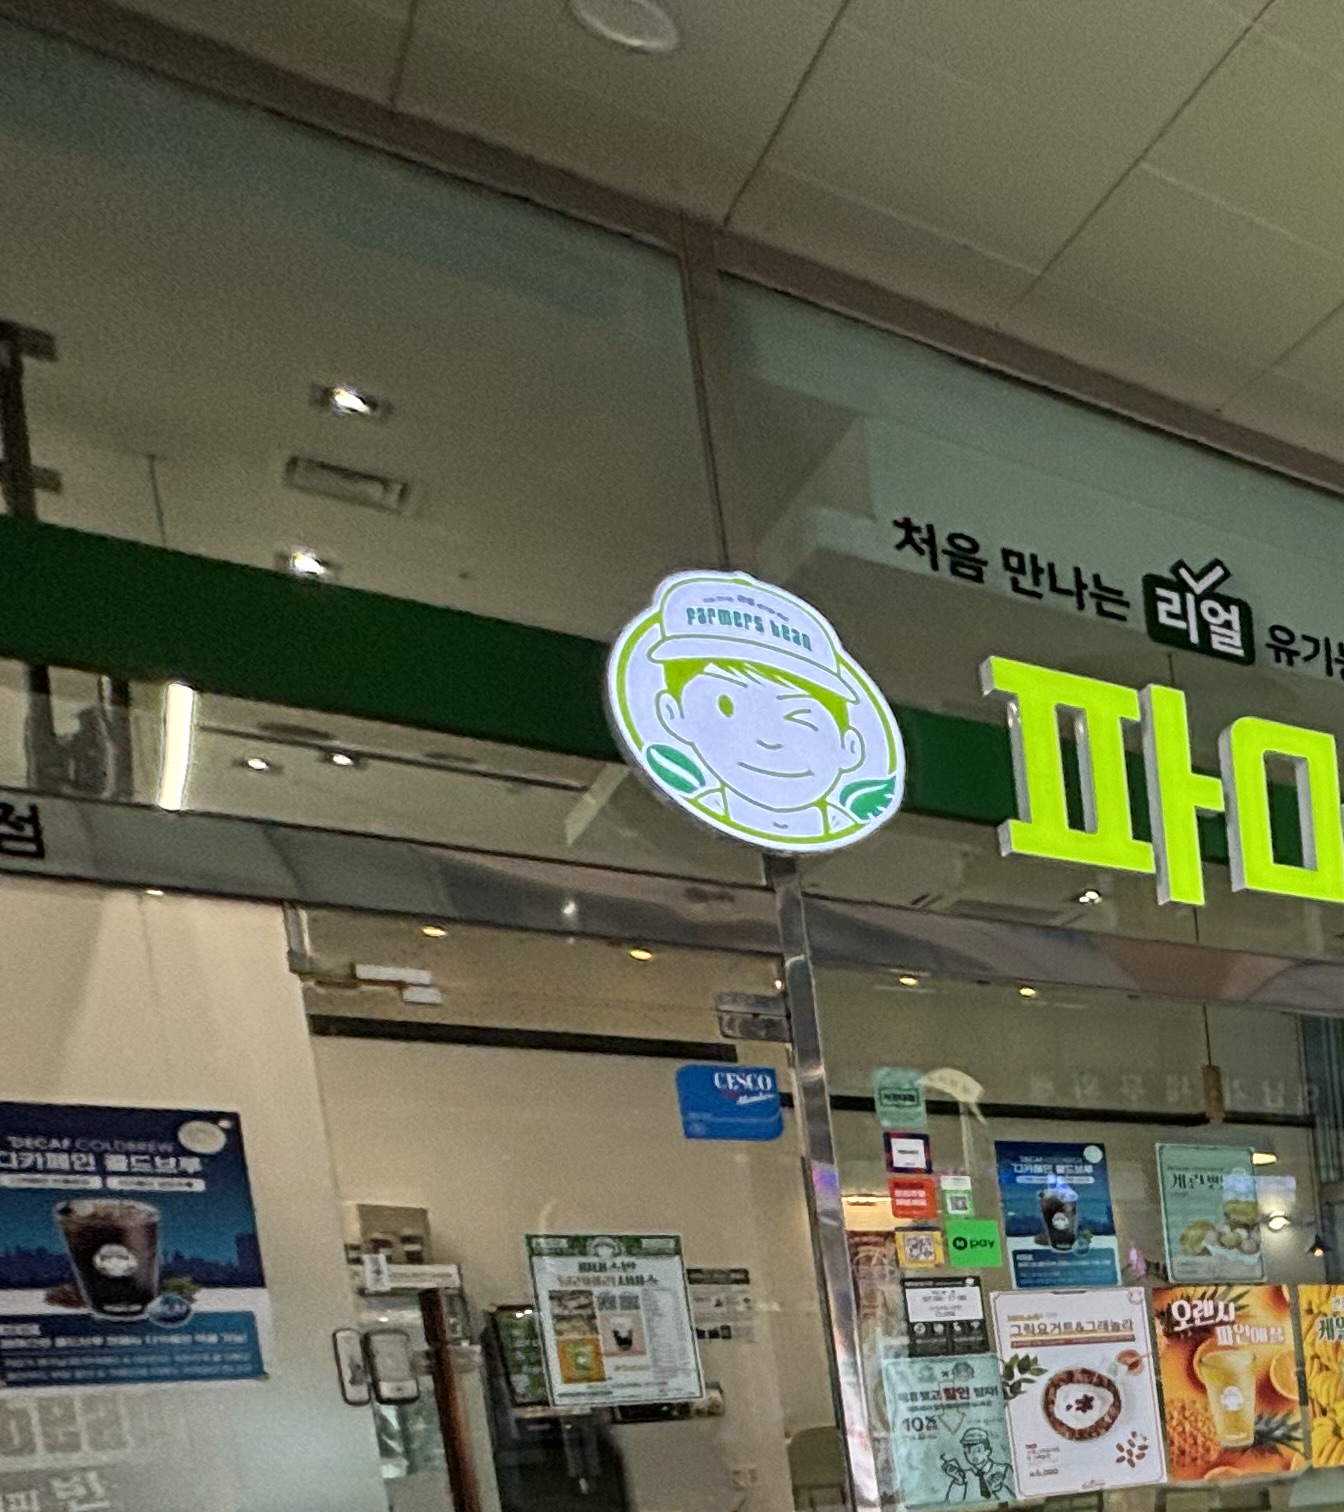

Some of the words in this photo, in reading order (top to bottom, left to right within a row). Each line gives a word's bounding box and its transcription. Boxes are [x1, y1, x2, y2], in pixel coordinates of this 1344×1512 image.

[892, 517, 988, 585] 처음
[1001, 546, 1132, 622] 만나는
[1154, 586, 1247, 658] 리얼
[713, 1071, 773, 1092] CESCO
[970, 1237, 996, 1251] pay
[1170, 1298, 1236, 1333] 오렌지
